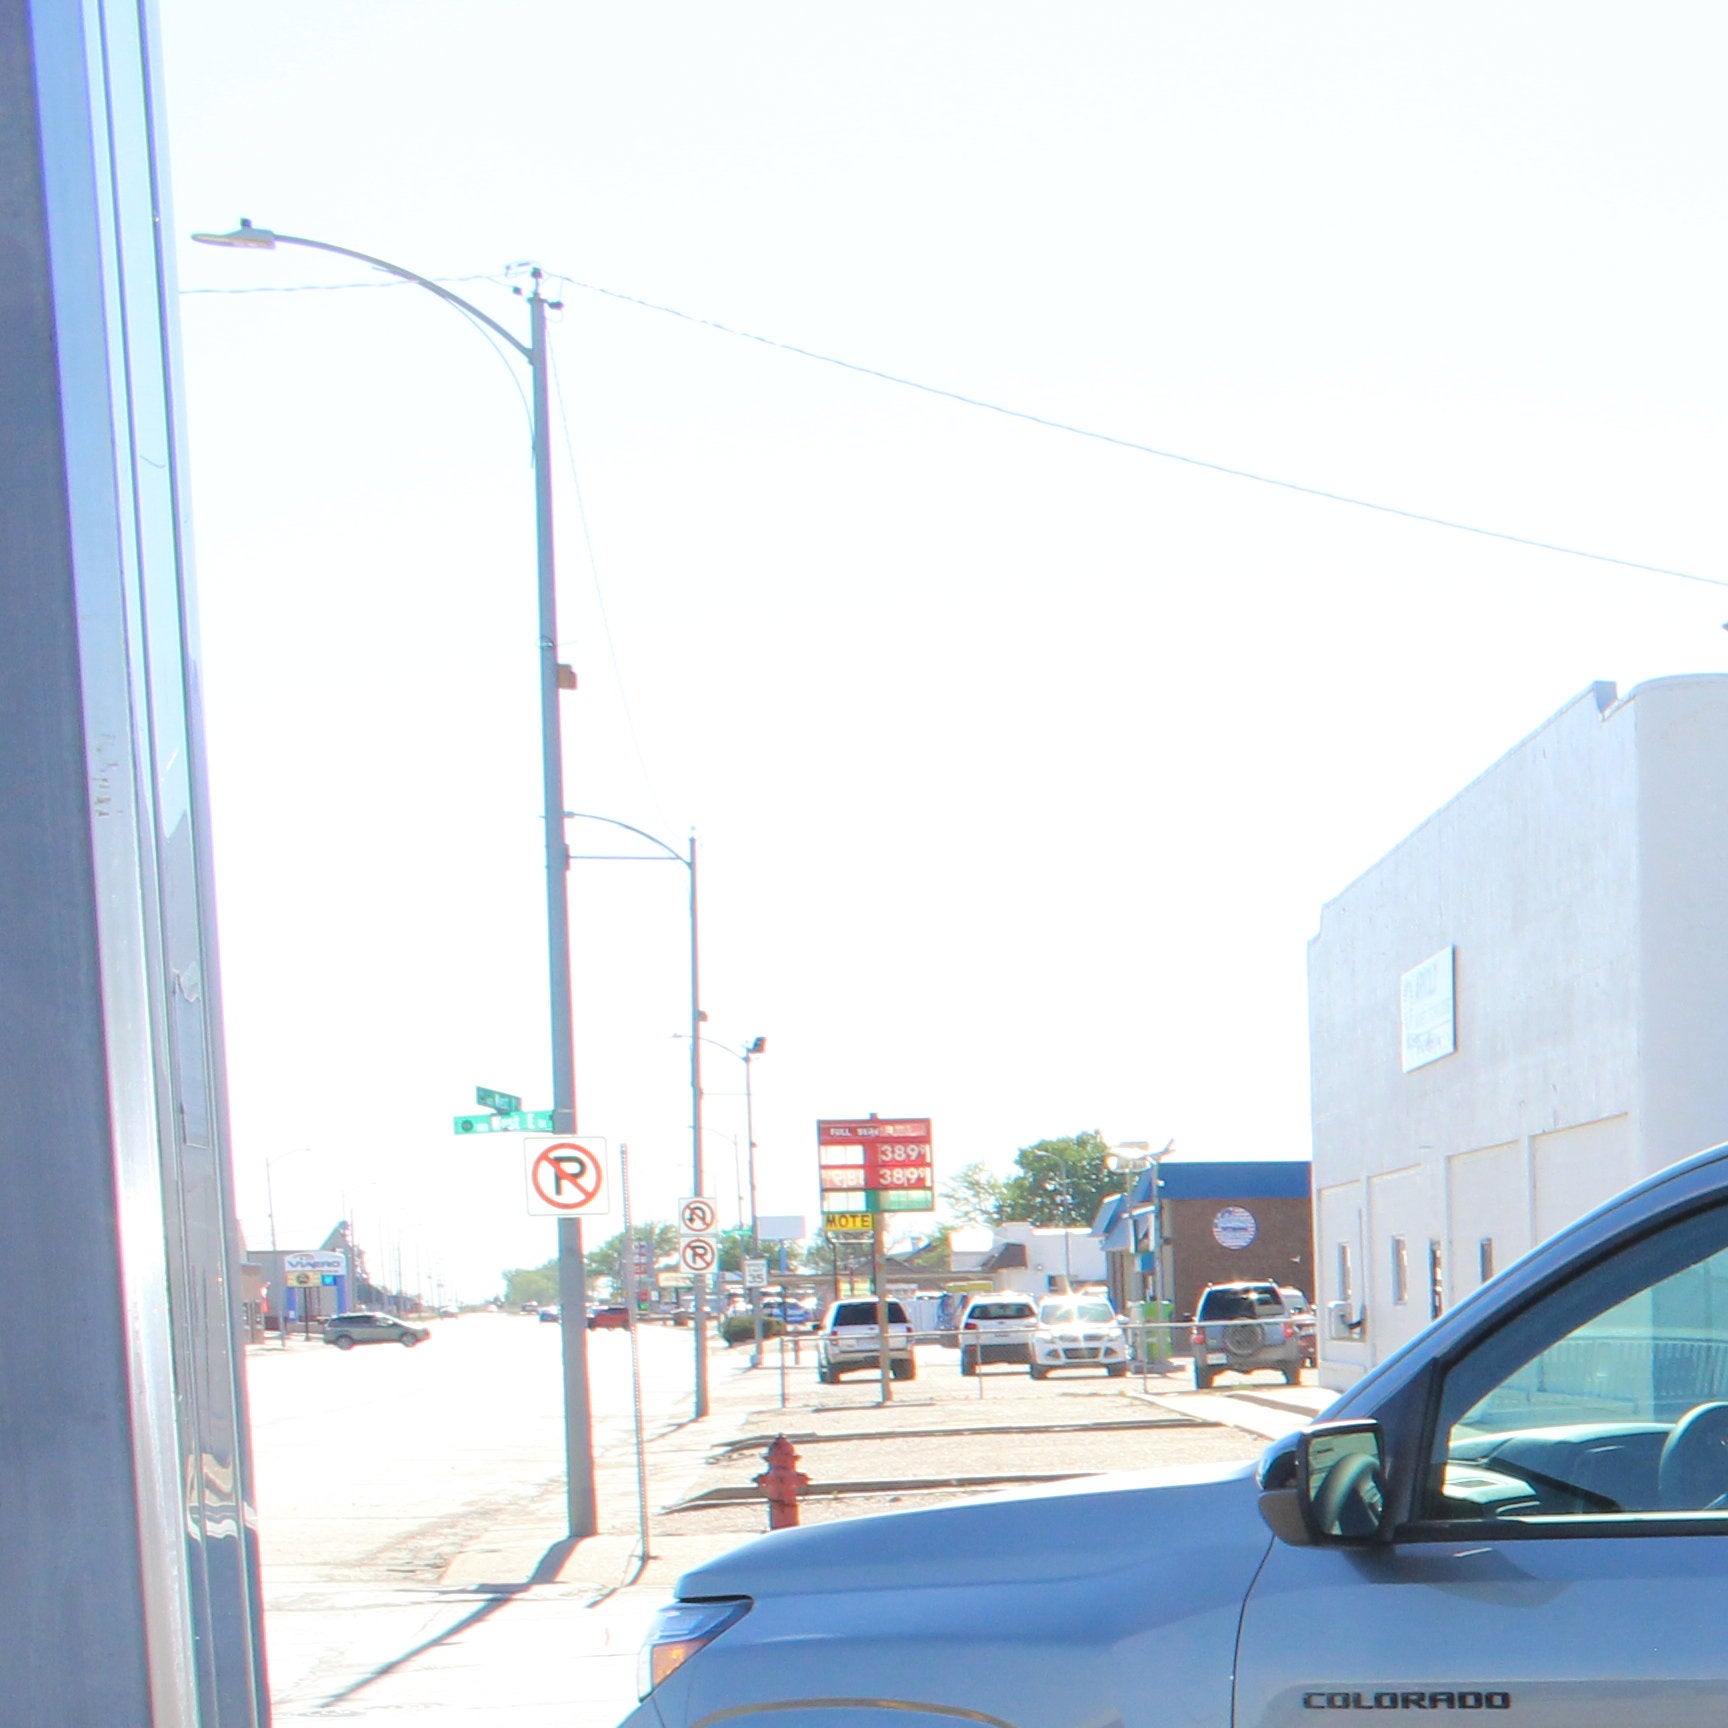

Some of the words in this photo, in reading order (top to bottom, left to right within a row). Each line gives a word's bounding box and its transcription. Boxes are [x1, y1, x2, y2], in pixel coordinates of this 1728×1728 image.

[553, 1156, 587, 1196] P
[826, 1214, 874, 1229] MOTE
[1303, 1691, 1512, 1710] COLORADO
